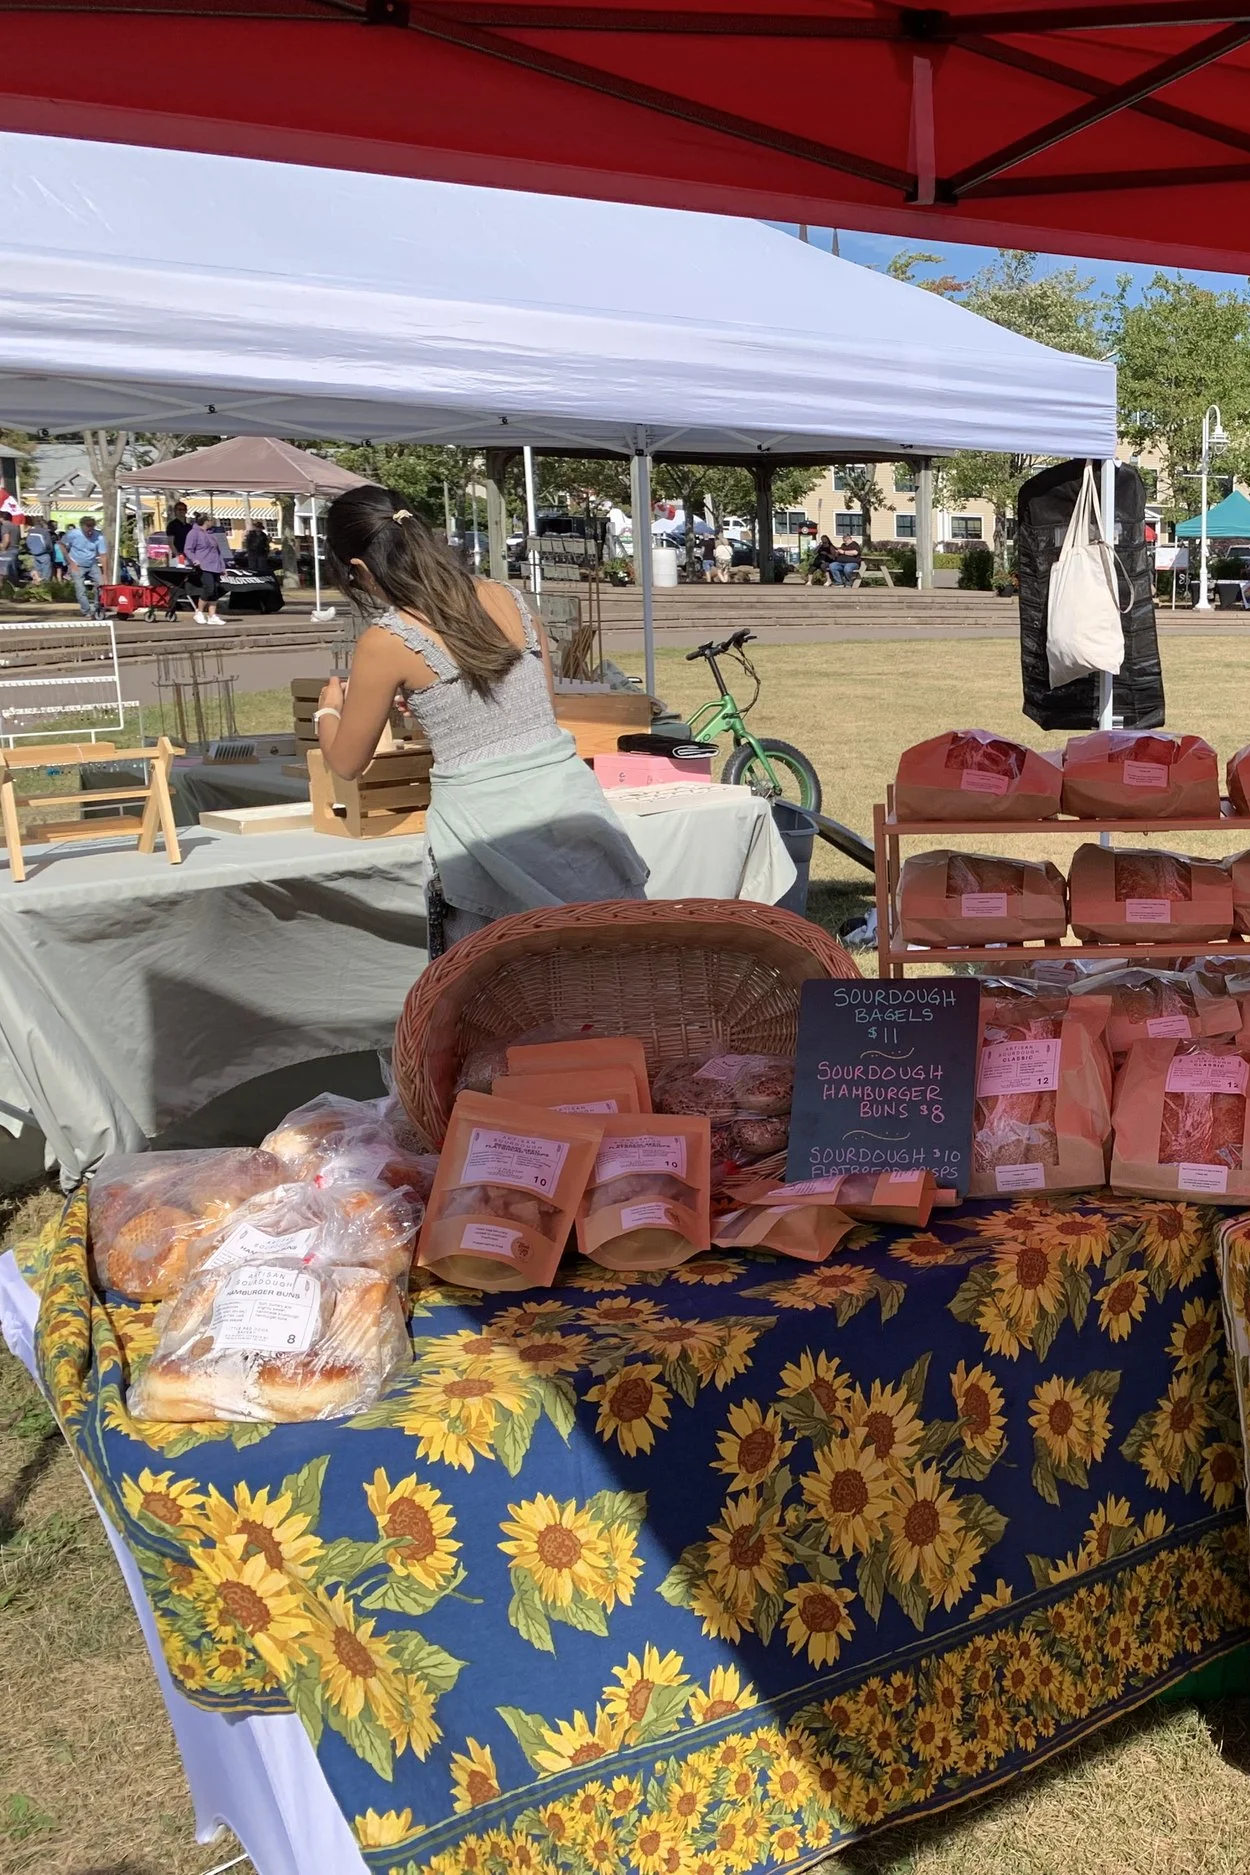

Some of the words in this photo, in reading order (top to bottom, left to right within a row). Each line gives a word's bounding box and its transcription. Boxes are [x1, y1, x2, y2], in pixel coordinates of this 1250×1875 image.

[833, 988, 957, 1007] SOURDOUGH
[855, 1008, 934, 1023] BAGELS
[868, 1026, 898, 1043] $11
[817, 1061, 943, 1080] SOURDOUGH
[1037, 1077, 1049, 1085] 12
[823, 1084, 943, 1101] HAMBURGER
[860, 1101, 909, 1118] BUNS
[920, 1104, 945, 1123] $8
[809, 1146, 925, 1163] SOURDOUGH
[932, 1148, 961, 1162] $10
[534, 1176, 547, 1187] 10
[276, 1290, 300, 1299] BUNS
[287, 1334, 296, 1344] 8
